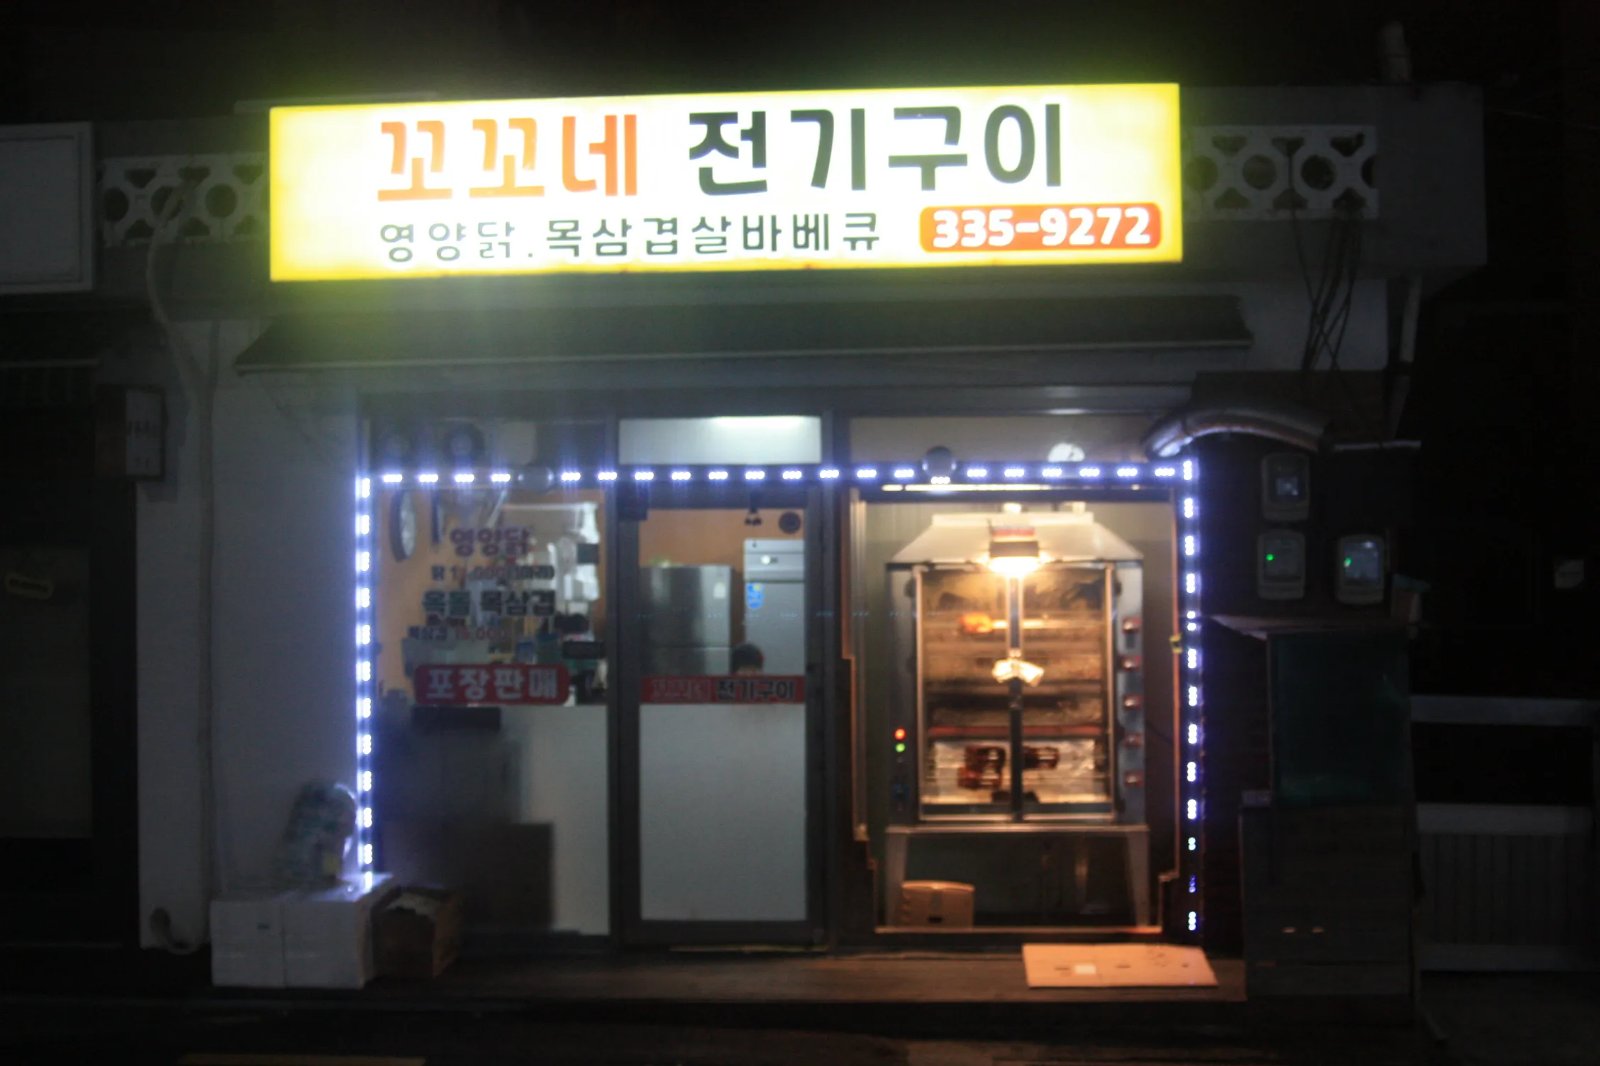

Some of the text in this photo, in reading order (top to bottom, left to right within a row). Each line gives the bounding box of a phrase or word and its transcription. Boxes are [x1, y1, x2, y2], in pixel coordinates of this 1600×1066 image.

[377, 103, 1062, 202] 꼬꼬네 전기구이
[932, 207, 1151, 248] 335-9272
[449, 527, 531, 558] 영양닭
[481, 589, 556, 617] 목삼겹
[426, 667, 560, 701] 포장판매
[717, 678, 796, 701] 전기구이
